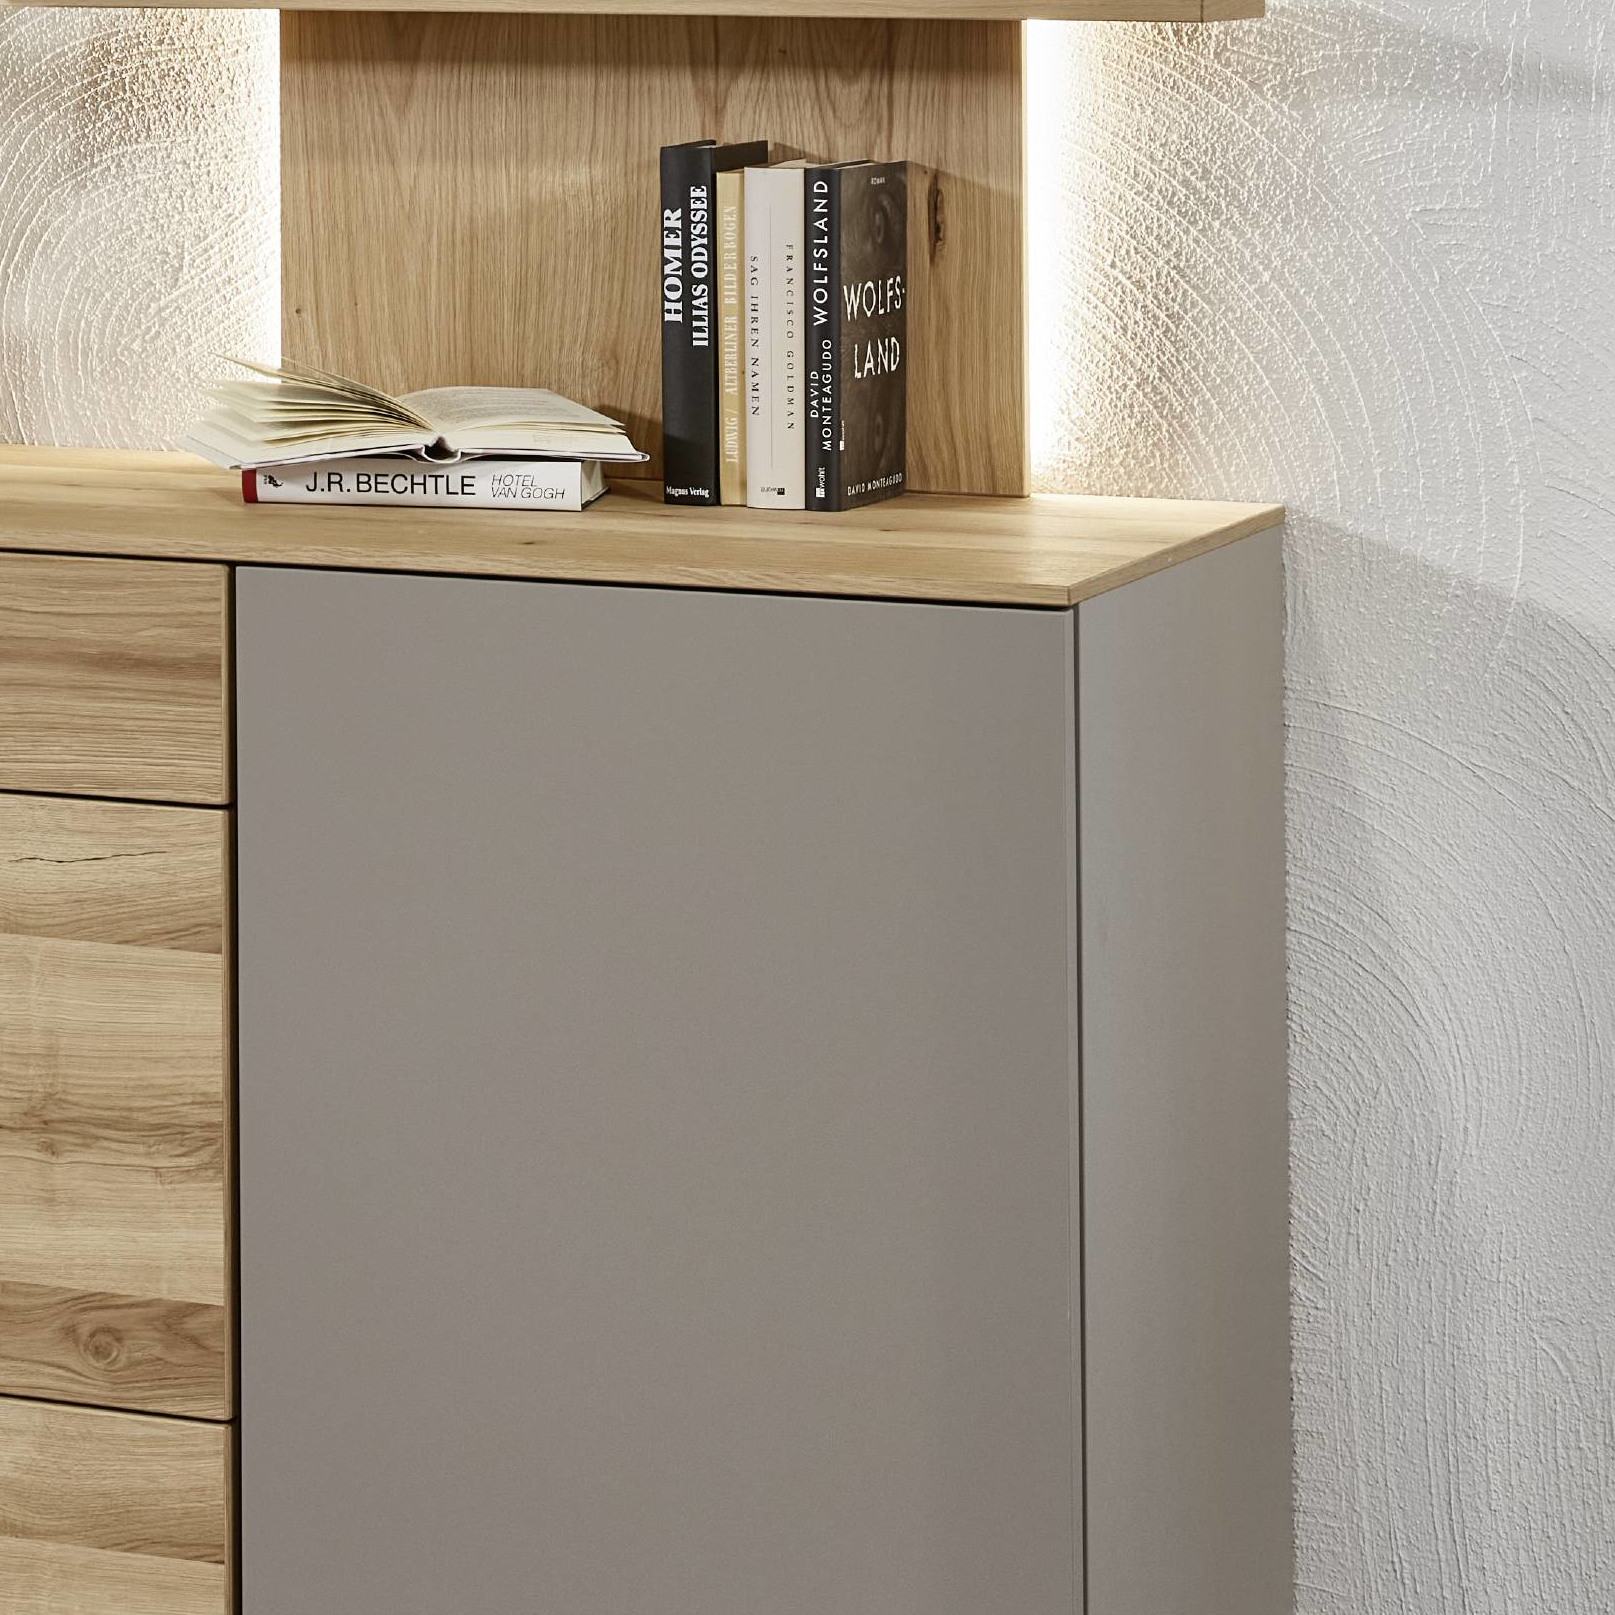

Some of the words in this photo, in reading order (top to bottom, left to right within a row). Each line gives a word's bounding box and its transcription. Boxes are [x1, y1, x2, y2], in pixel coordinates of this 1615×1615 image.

[690, 185, 708, 278] ODYSSEE
[813, 180, 829, 326] WOLFSLAND
[663, 207, 683, 324] HOMER
[749, 255, 759, 287] SAG
[692, 281, 709, 347] ILLIAS
[785, 244, 795, 340] FRANCISCO
[843, 275, 906, 322] WOLFS-
[750, 295, 760, 347] IHREN
[723, 316, 738, 396] ALTBERLINER
[853, 336, 901, 379] LAND
[750, 357, 760, 417] NAMEN
[786, 349, 796, 430] GOLDMAN
[810, 370, 819, 419] DAVID
[822, 339, 833, 451] MONTEAGUDO
[305, 472, 351, 494] J.R.
[357, 472, 477, 497] BECHTLE
[491, 474, 537, 487] HOTEL
[491, 485, 520, 498] VAN
[520, 486, 566, 499] GOGH
[666, 486, 688, 496] Magnus
[689, 487, 711, 498] Verlag
[847, 482, 866, 497] DAVID
[867, 473, 903, 492] MONTEAGUDO
